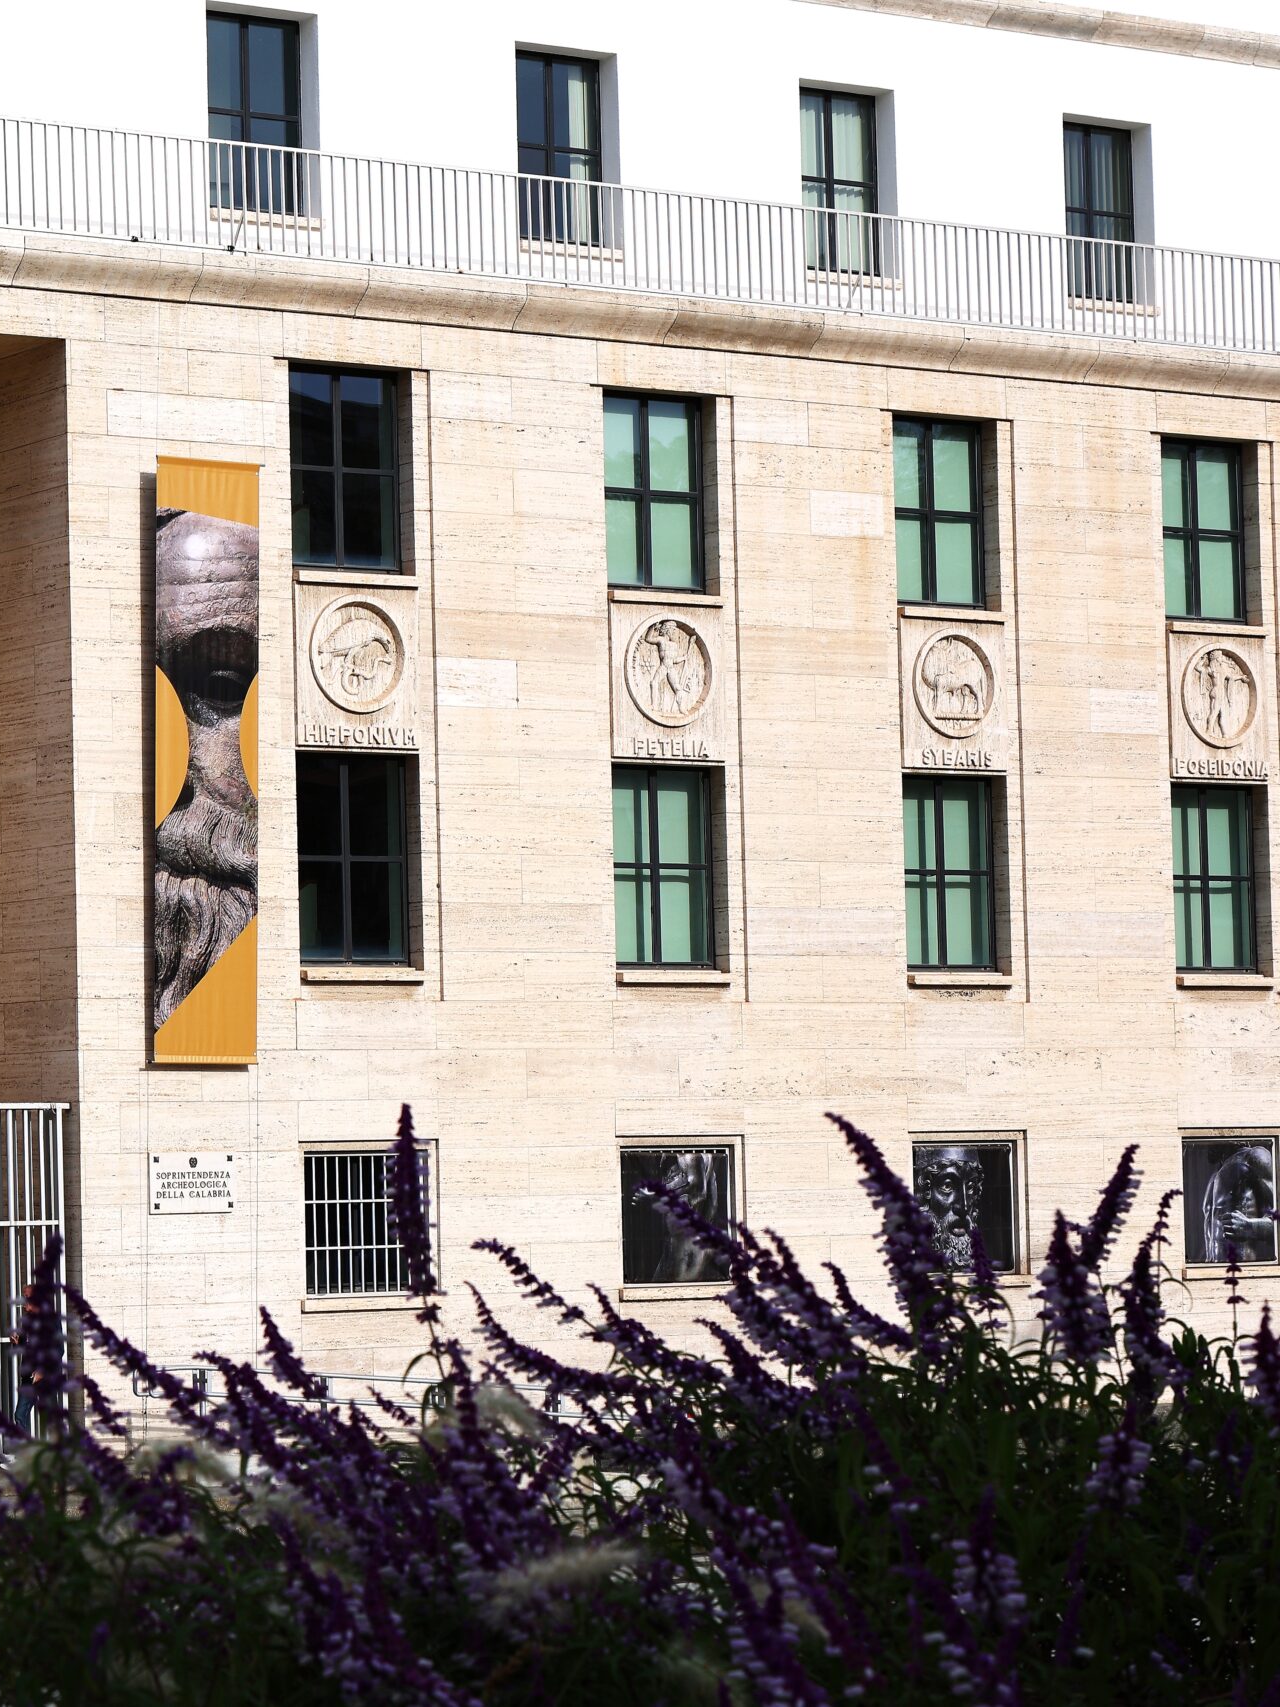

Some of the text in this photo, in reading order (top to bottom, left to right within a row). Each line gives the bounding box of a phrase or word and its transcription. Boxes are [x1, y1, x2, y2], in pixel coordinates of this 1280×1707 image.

[304, 724, 416, 746] HIPPONIVM
[633, 737, 709, 758] PETELIA
[922, 748, 993, 769] SYBARIS
[1174, 757, 1269, 778] POSEIDONIA
[156, 1171, 231, 1180] SOPRINTENDENZA
[161, 1181, 227, 1189] ARCHEOLOGICA
[156, 1190, 232, 1199] DELLA CALABRIA
